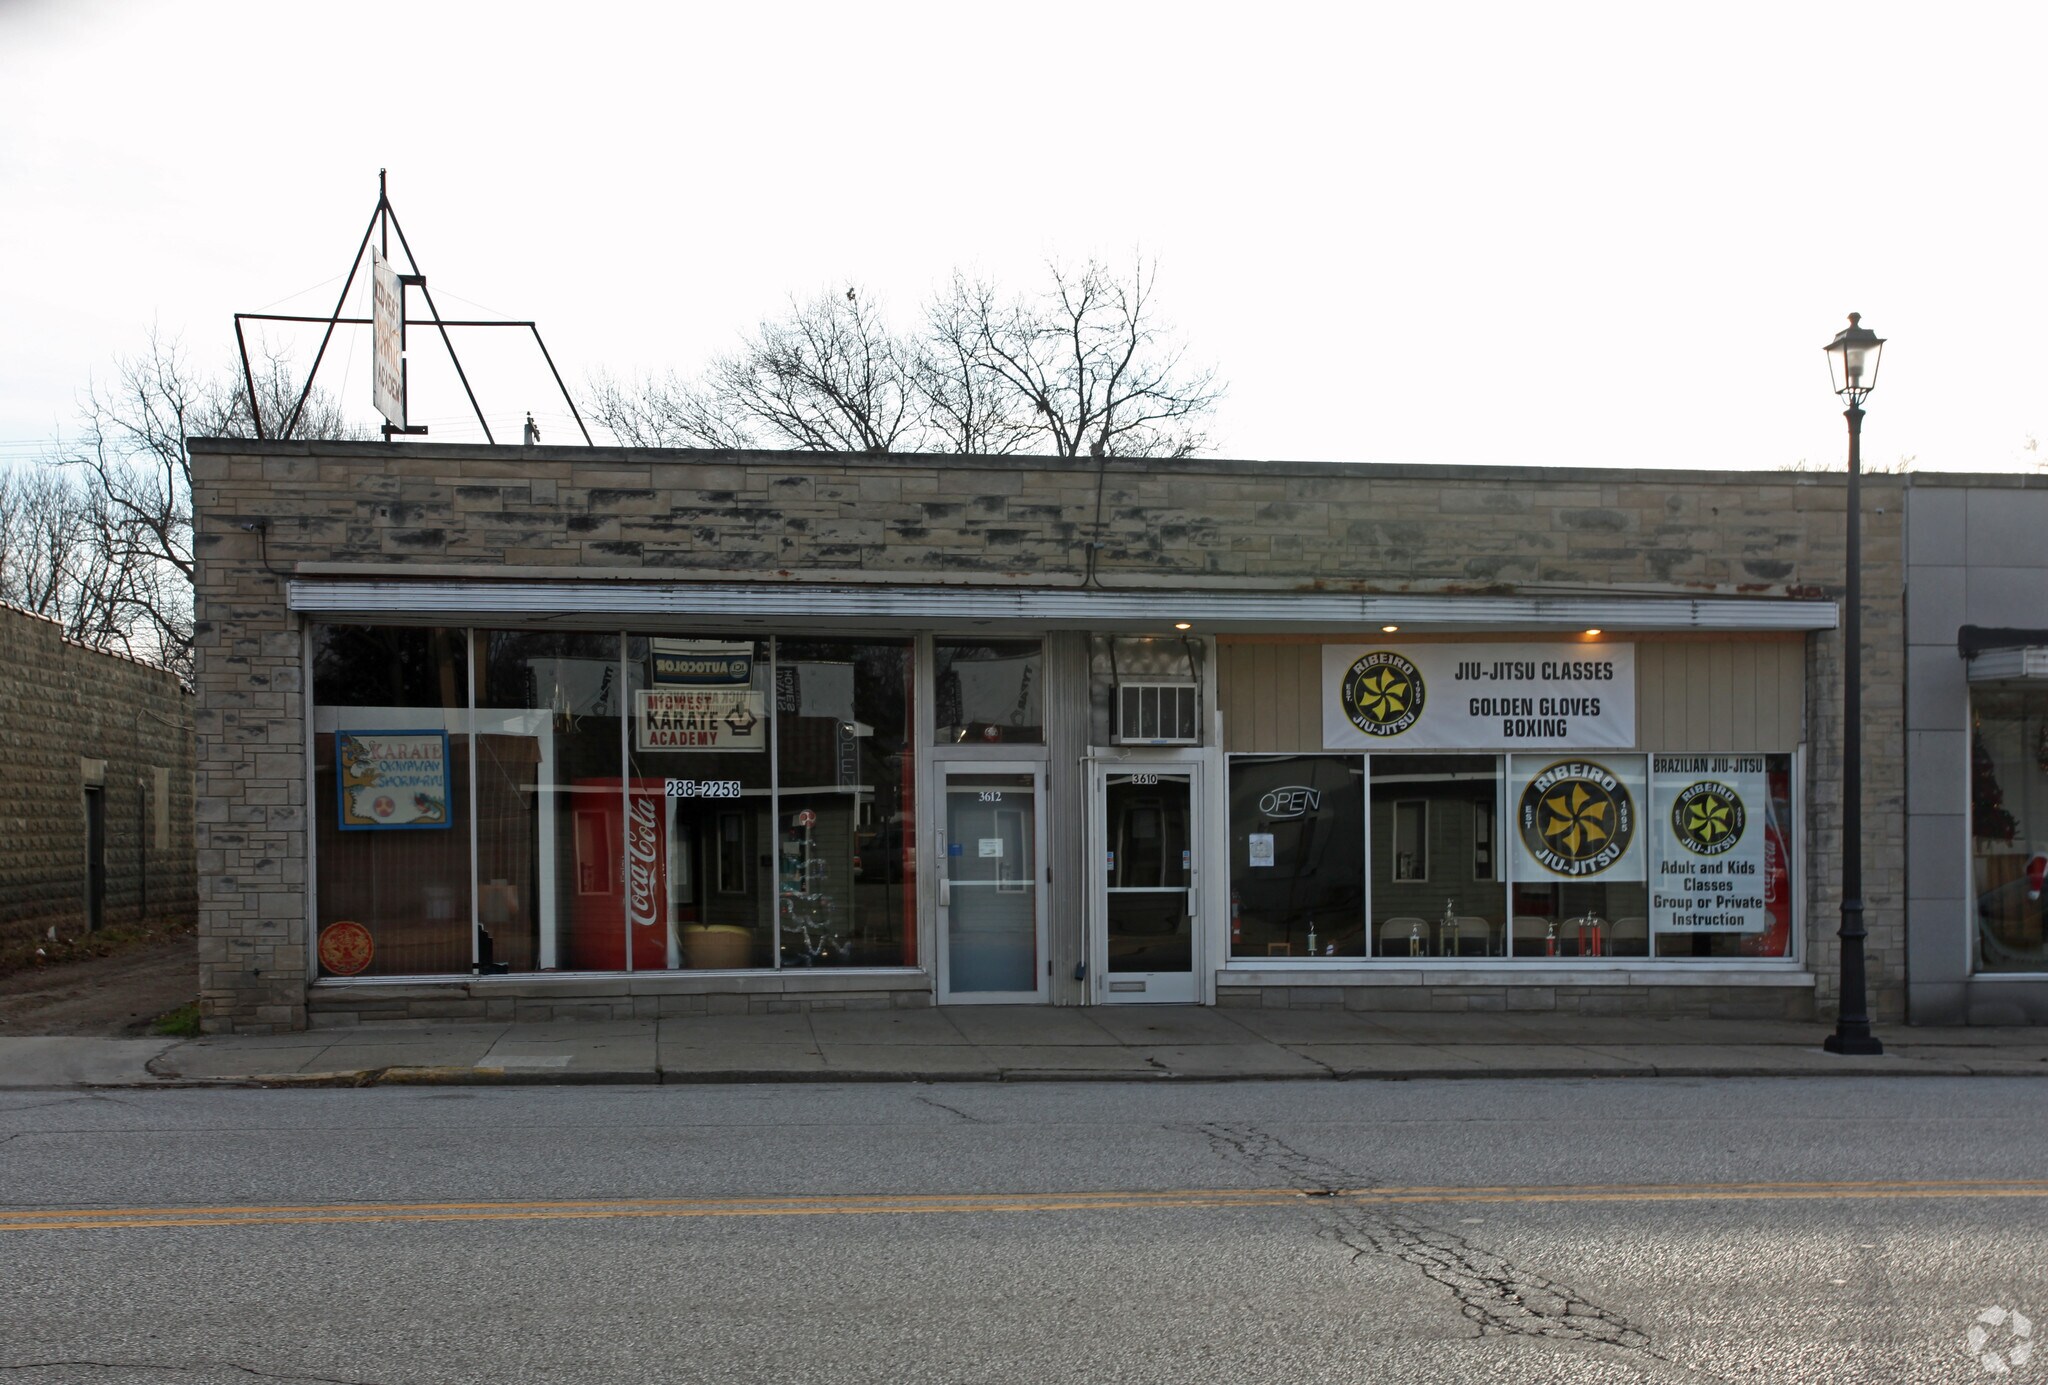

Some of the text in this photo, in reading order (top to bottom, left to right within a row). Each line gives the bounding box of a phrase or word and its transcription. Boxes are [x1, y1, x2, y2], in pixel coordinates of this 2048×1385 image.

[1353, 653, 1414, 675] RIBEIRO
[1455, 662, 1613, 680] JIU-JITSU CLASSES
[647, 696, 713, 710] MIDWEST
[1469, 698, 1601, 716] GOLDEN GLOVES
[647, 711, 718, 730] KARATE
[1353, 712, 1415, 735] JIU-JITSU
[1504, 719, 1567, 737] BOXING
[649, 732, 718, 745] ACADEMY
[370, 743, 443, 759] KARATE
[839, 721, 857, 792] OPEN
[1653, 758, 1763, 773] BRAZILIAN JIU-JITSU
[1133, 774, 1157, 784] 3610
[1534, 763, 1617, 793] RIBEIRO
[666, 781, 740, 797] 288-2258
[979, 791, 1002, 802] 3612
[1682, 783, 1736, 802] RIBEIRO
[1260, 790, 1321, 813] OPEN
[1620, 800, 1628, 832] 1995
[1682, 833, 1737, 855] JIU-JITSU
[1535, 842, 1620, 874] JIU-JITSU
[1661, 861, 1755, 874] Adult and Kids
[1684, 878, 1733, 891] Classes
[1654, 895, 1763, 911] Group or Private
[1672, 912, 1744, 925] Instruction
